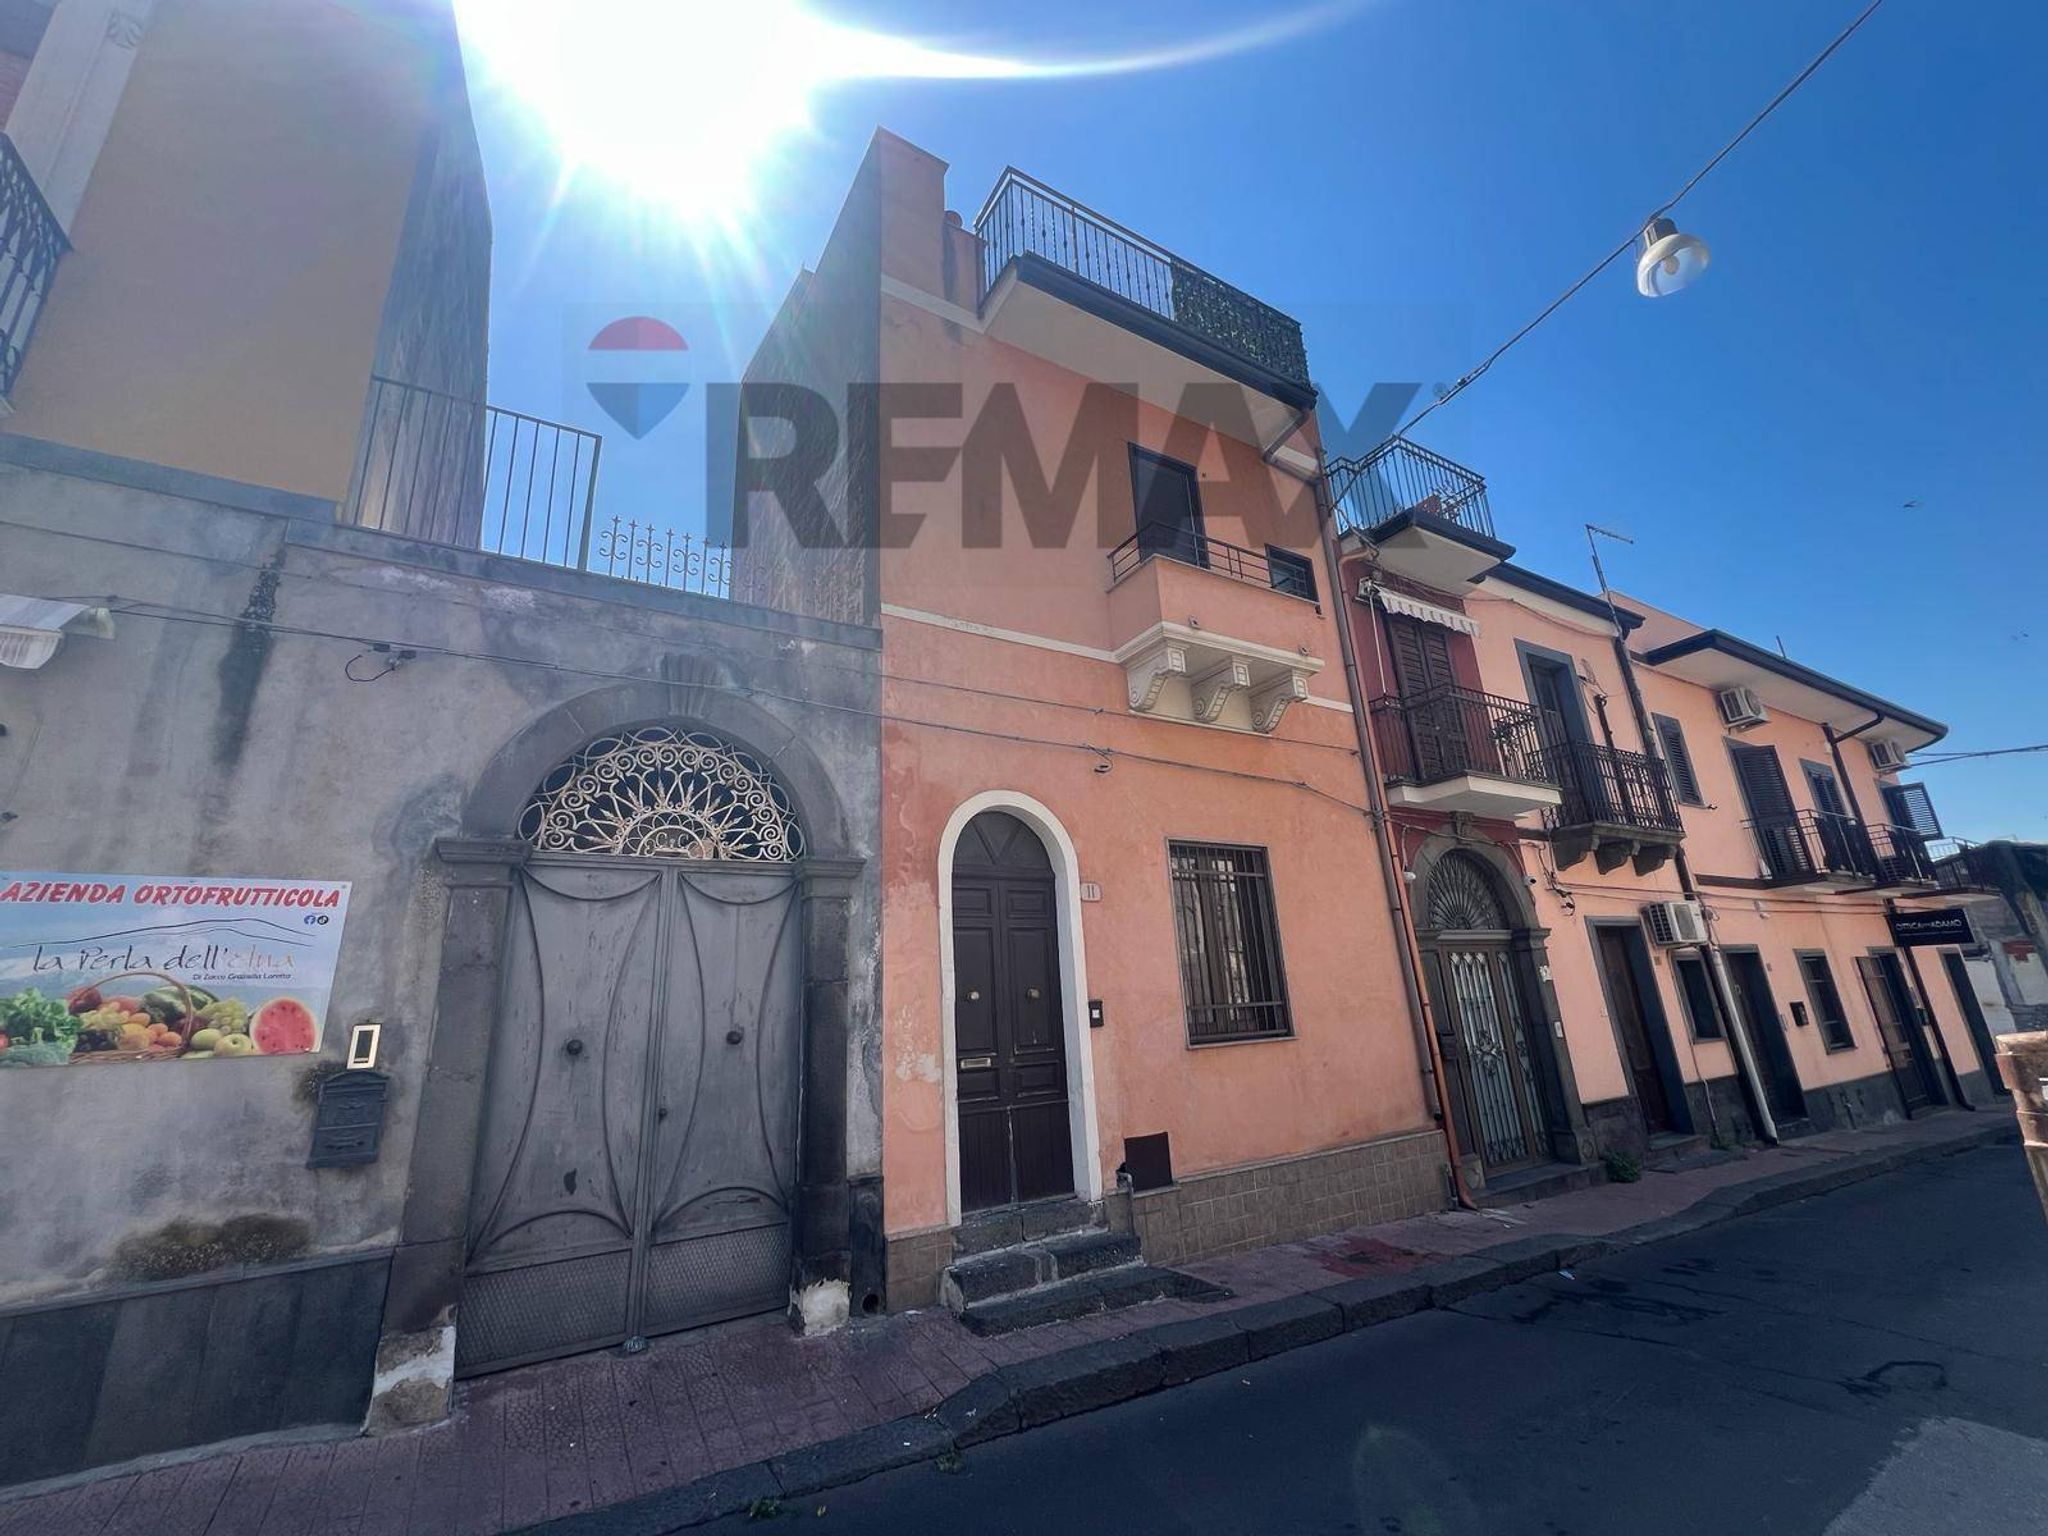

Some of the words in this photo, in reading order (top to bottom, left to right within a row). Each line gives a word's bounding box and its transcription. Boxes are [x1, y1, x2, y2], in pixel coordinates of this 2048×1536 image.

[0, 881, 126, 904] AZIENDA
[133, 884, 341, 908] ORTOFRUTTICOLA
[79, 944, 153, 972] Perla
